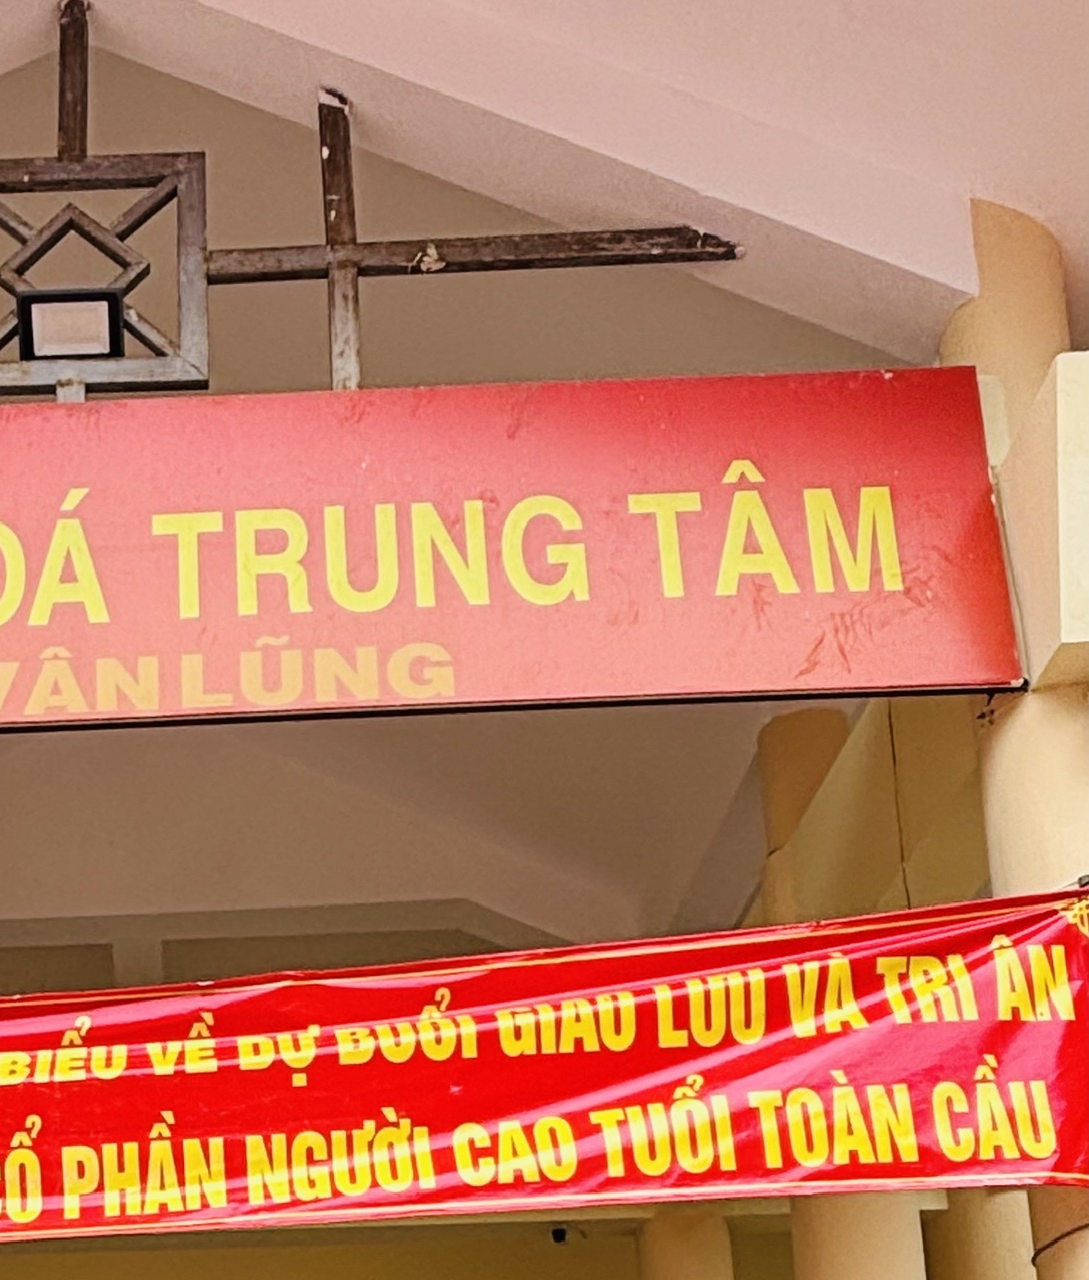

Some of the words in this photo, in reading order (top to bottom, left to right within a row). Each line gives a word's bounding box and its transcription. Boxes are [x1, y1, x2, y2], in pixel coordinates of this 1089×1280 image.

[151, 495, 590, 619] TRUNG
[627, 459, 904, 599] TÂM
[180, 635, 454, 707] LŨNG
[145, 1011, 218, 1076] VỀ
[236, 1023, 320, 1088] DỰ
[334, 987, 479, 1066] BUỔI
[876, 953, 979, 1024] TRI
[992, 933, 1076, 1022] ÂN
[61, 1110, 229, 1220] PHẦN
[245, 1107, 437, 1206] NGƯỜI
[451, 1114, 579, 1188] CAO
[589, 1074, 737, 1177] TUỔI
[748, 1069, 919, 1170] TOÀN
[932, 1053, 1058, 1162] CẦU
